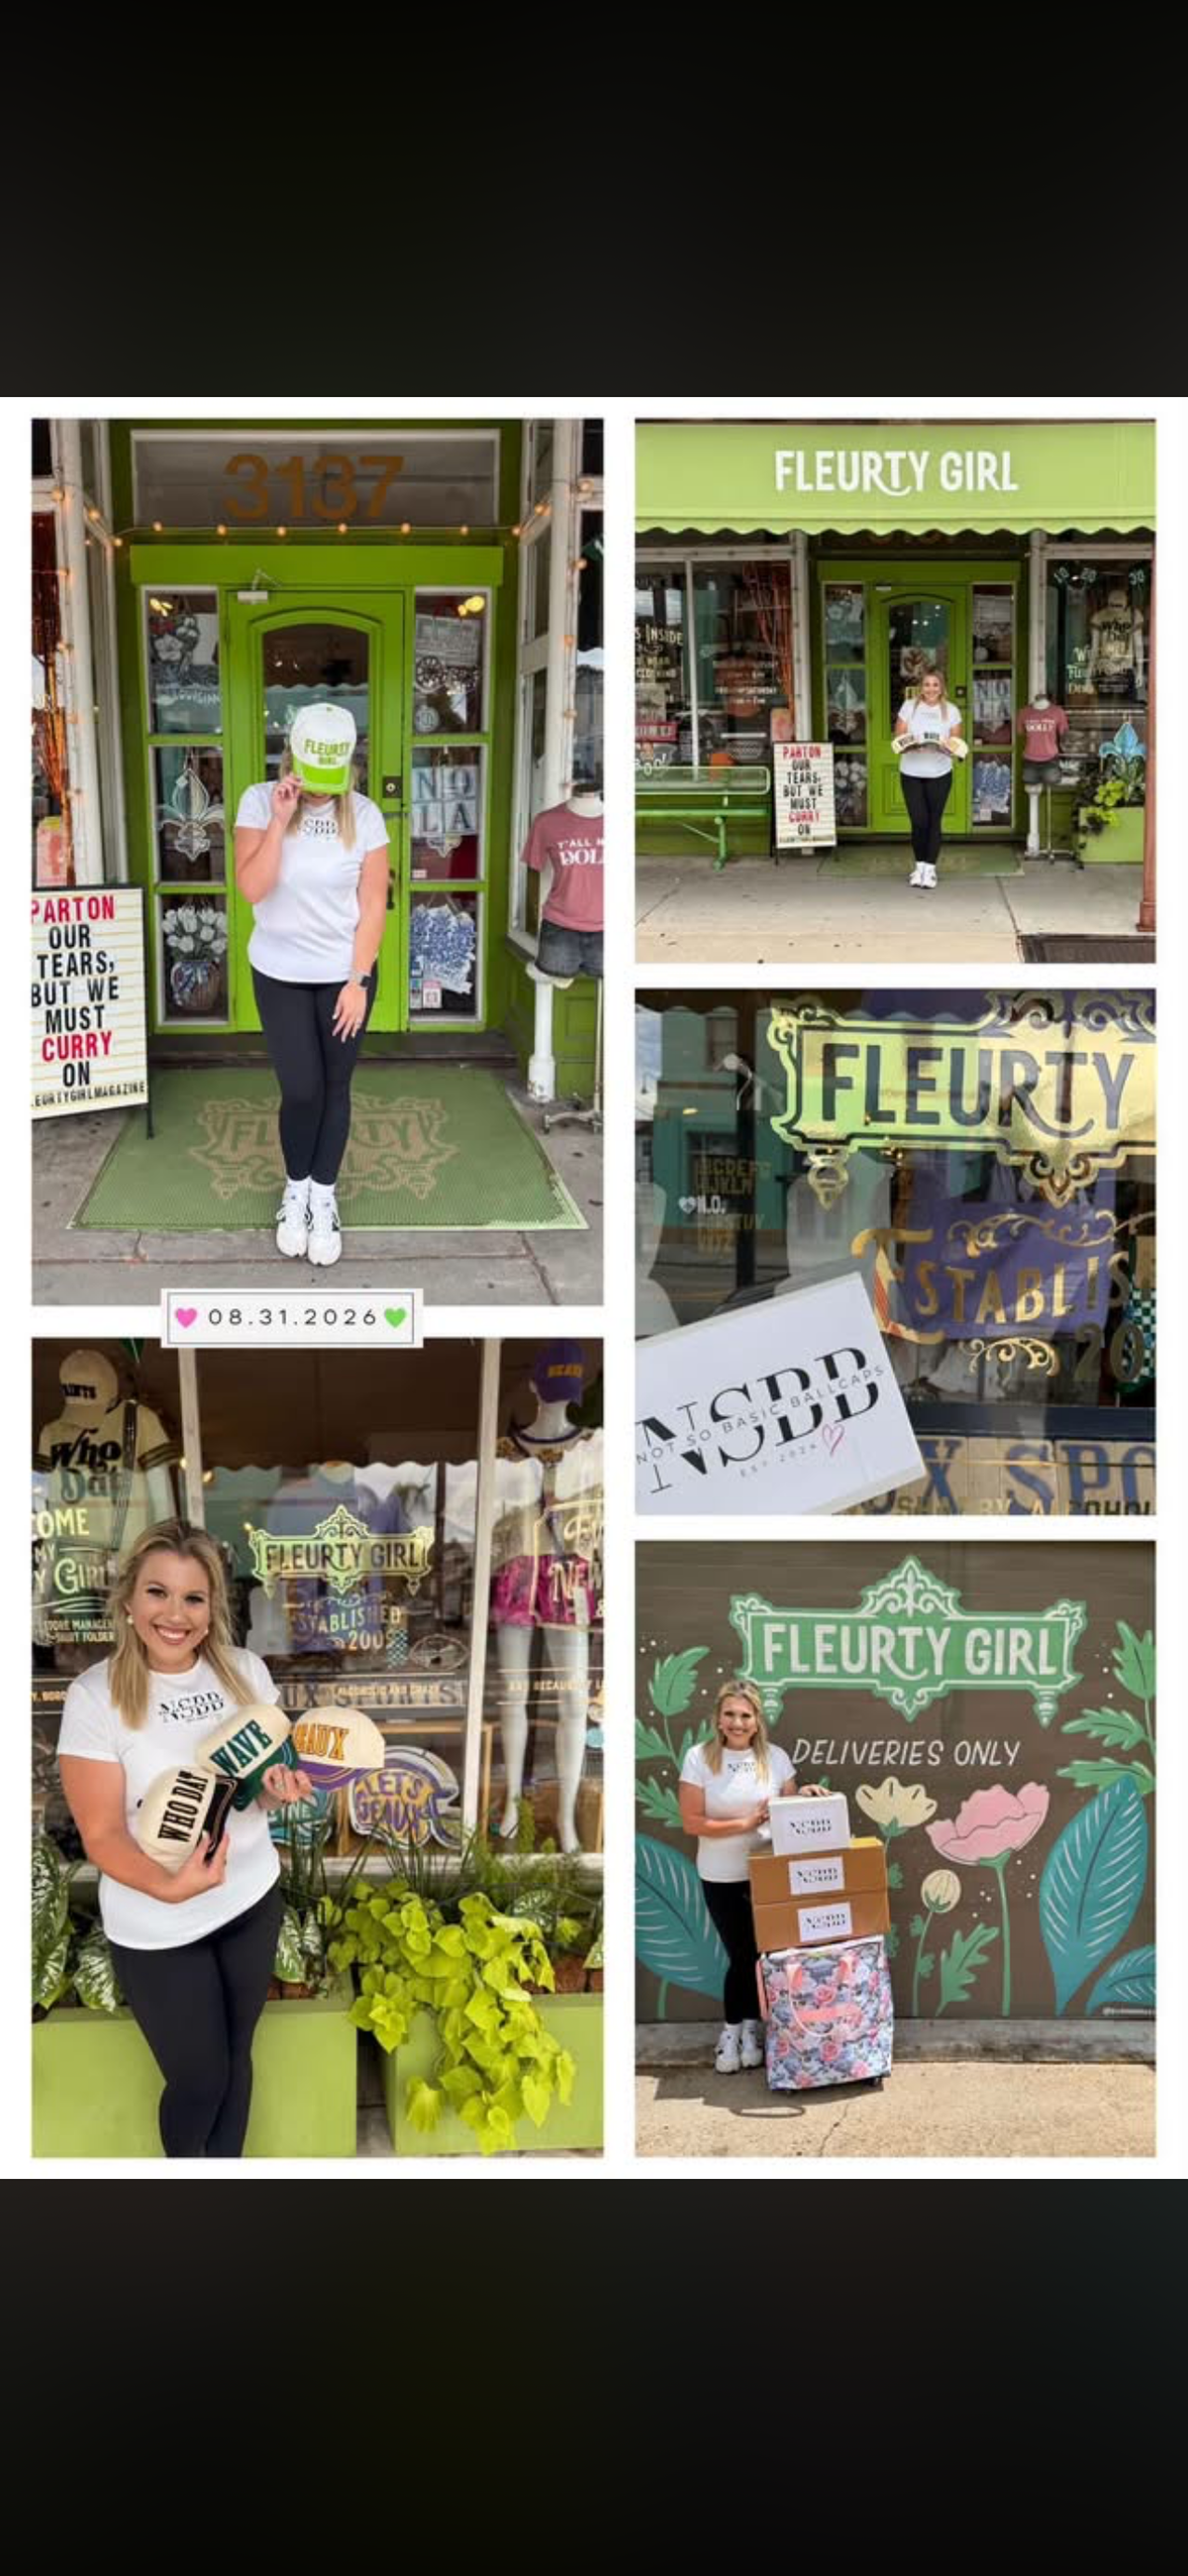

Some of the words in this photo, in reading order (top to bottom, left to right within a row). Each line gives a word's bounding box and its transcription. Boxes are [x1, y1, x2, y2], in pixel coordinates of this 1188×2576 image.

[225, 454, 405, 520] 3137
[775, 450, 929, 495] FLEURTY
[940, 450, 1019, 490] GIRL
[783, 746, 822, 759] PARTON
[792, 759, 811, 771] OUR
[783, 785, 802, 797] BUT
[790, 798, 816, 809] MUST
[31, 895, 115, 924] PARTON
[49, 924, 91, 949] OUR
[38, 951, 115, 979] TEARS,
[31, 980, 71, 1007] BUT
[87, 977, 119, 1001] WE
[46, 1005, 105, 1034] MUST
[42, 1031, 112, 1062] CURRY
[62, 1061, 91, 1087] ON
[822, 1043, 1136, 1139] FLEURTY
[636, 1442, 676, 1464] NOT
[686, 1429, 712, 1448] SO
[723, 1406, 778, 1433] BASIC
[790, 1365, 885, 1408] BALLCAPS
[50, 1428, 122, 1472] Who
[266, 1543, 362, 1572] FLEURTY
[370, 1543, 419, 1568] GIRL
[763, 1623, 949, 1681] FLEURTY
[965, 1626, 1057, 1676] GIRL
[209, 1719, 273, 1777] WAVE
[792, 1738, 943, 1768] DELIVERIES
[953, 1739, 1021, 1768] ONLY
[171, 1771, 208, 1803] DAT
[157, 1799, 199, 1842] WHO
